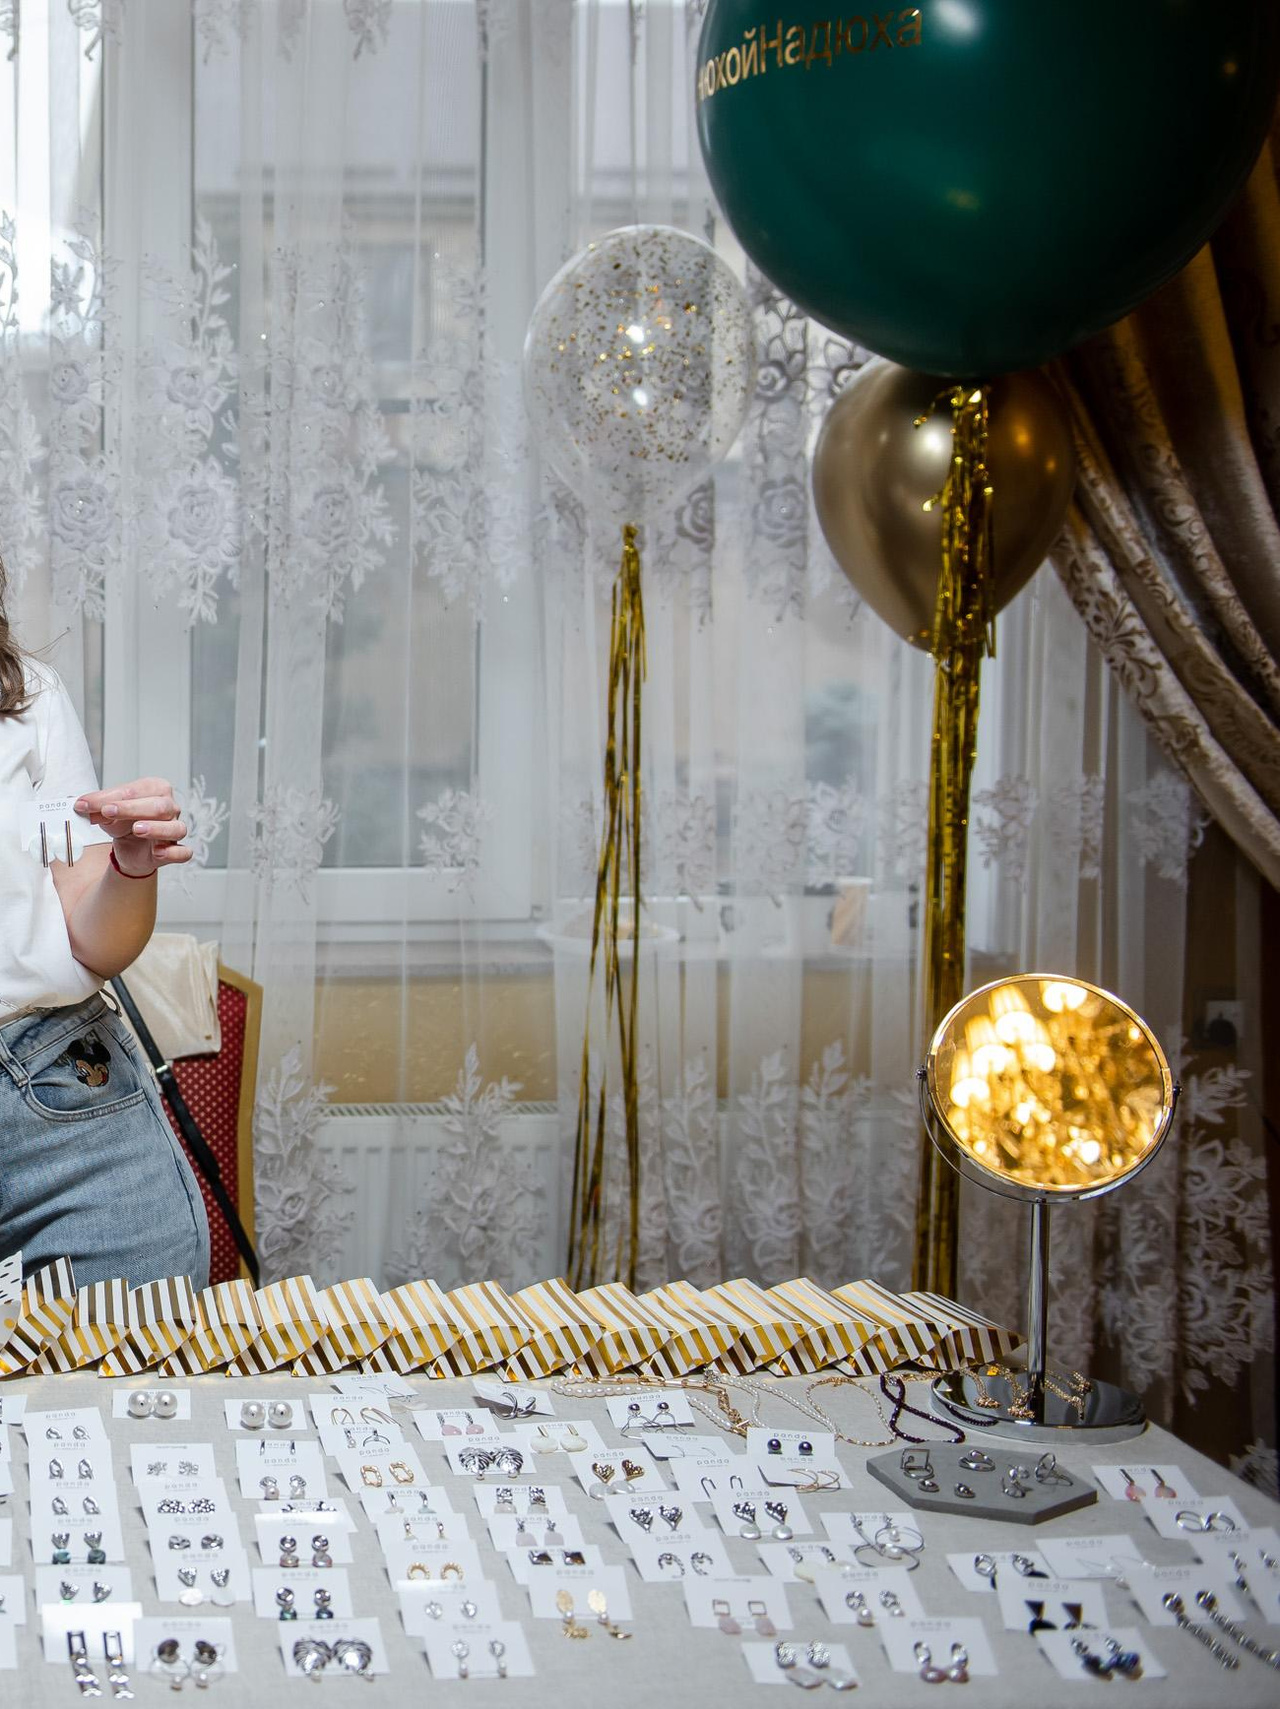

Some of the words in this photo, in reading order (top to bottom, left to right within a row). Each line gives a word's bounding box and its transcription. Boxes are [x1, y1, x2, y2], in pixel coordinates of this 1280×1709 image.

[39, 801, 67, 809] panda
[773, 1432, 807, 1440] panda
[359, 1447, 390, 1456] panda
[736, 1490, 770, 1498] panda
